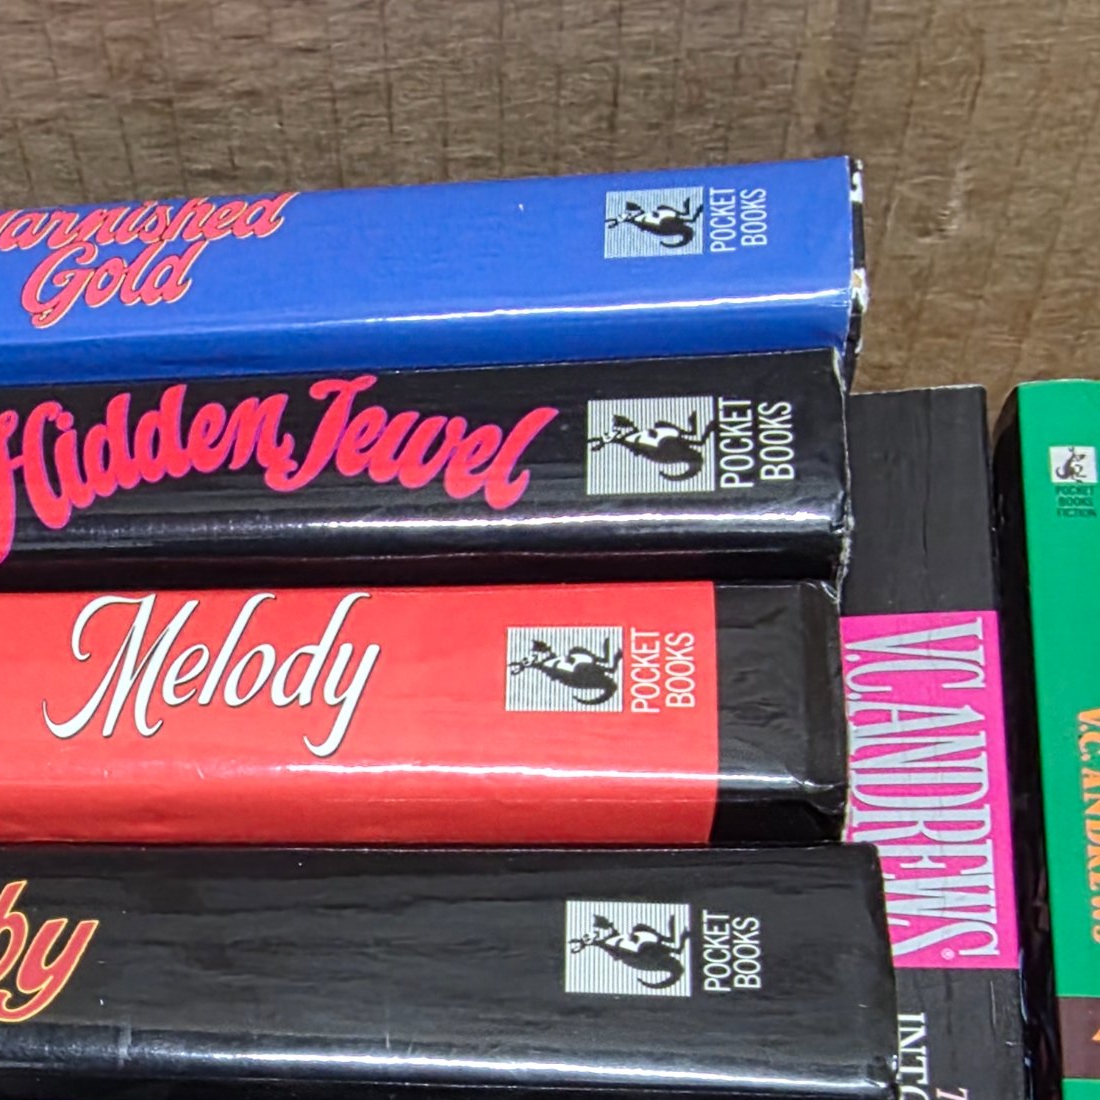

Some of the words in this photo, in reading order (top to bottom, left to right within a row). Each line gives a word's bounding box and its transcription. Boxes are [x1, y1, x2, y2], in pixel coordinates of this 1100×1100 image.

[709, 187, 736, 253] POCKET
[740, 188, 768, 246] BOOKS
[21, 240, 209, 328] Gold
[266, 375, 558, 509] Jewel
[718, 397, 754, 488] POCKET
[758, 401, 794, 480] BOOKS
[42, 592, 380, 757] Melody
[631, 627, 660, 713] POCKET
[665, 632, 695, 708] BOOKS
[703, 910, 731, 992] POCKET
[732, 917, 762, 989] BOOKS
